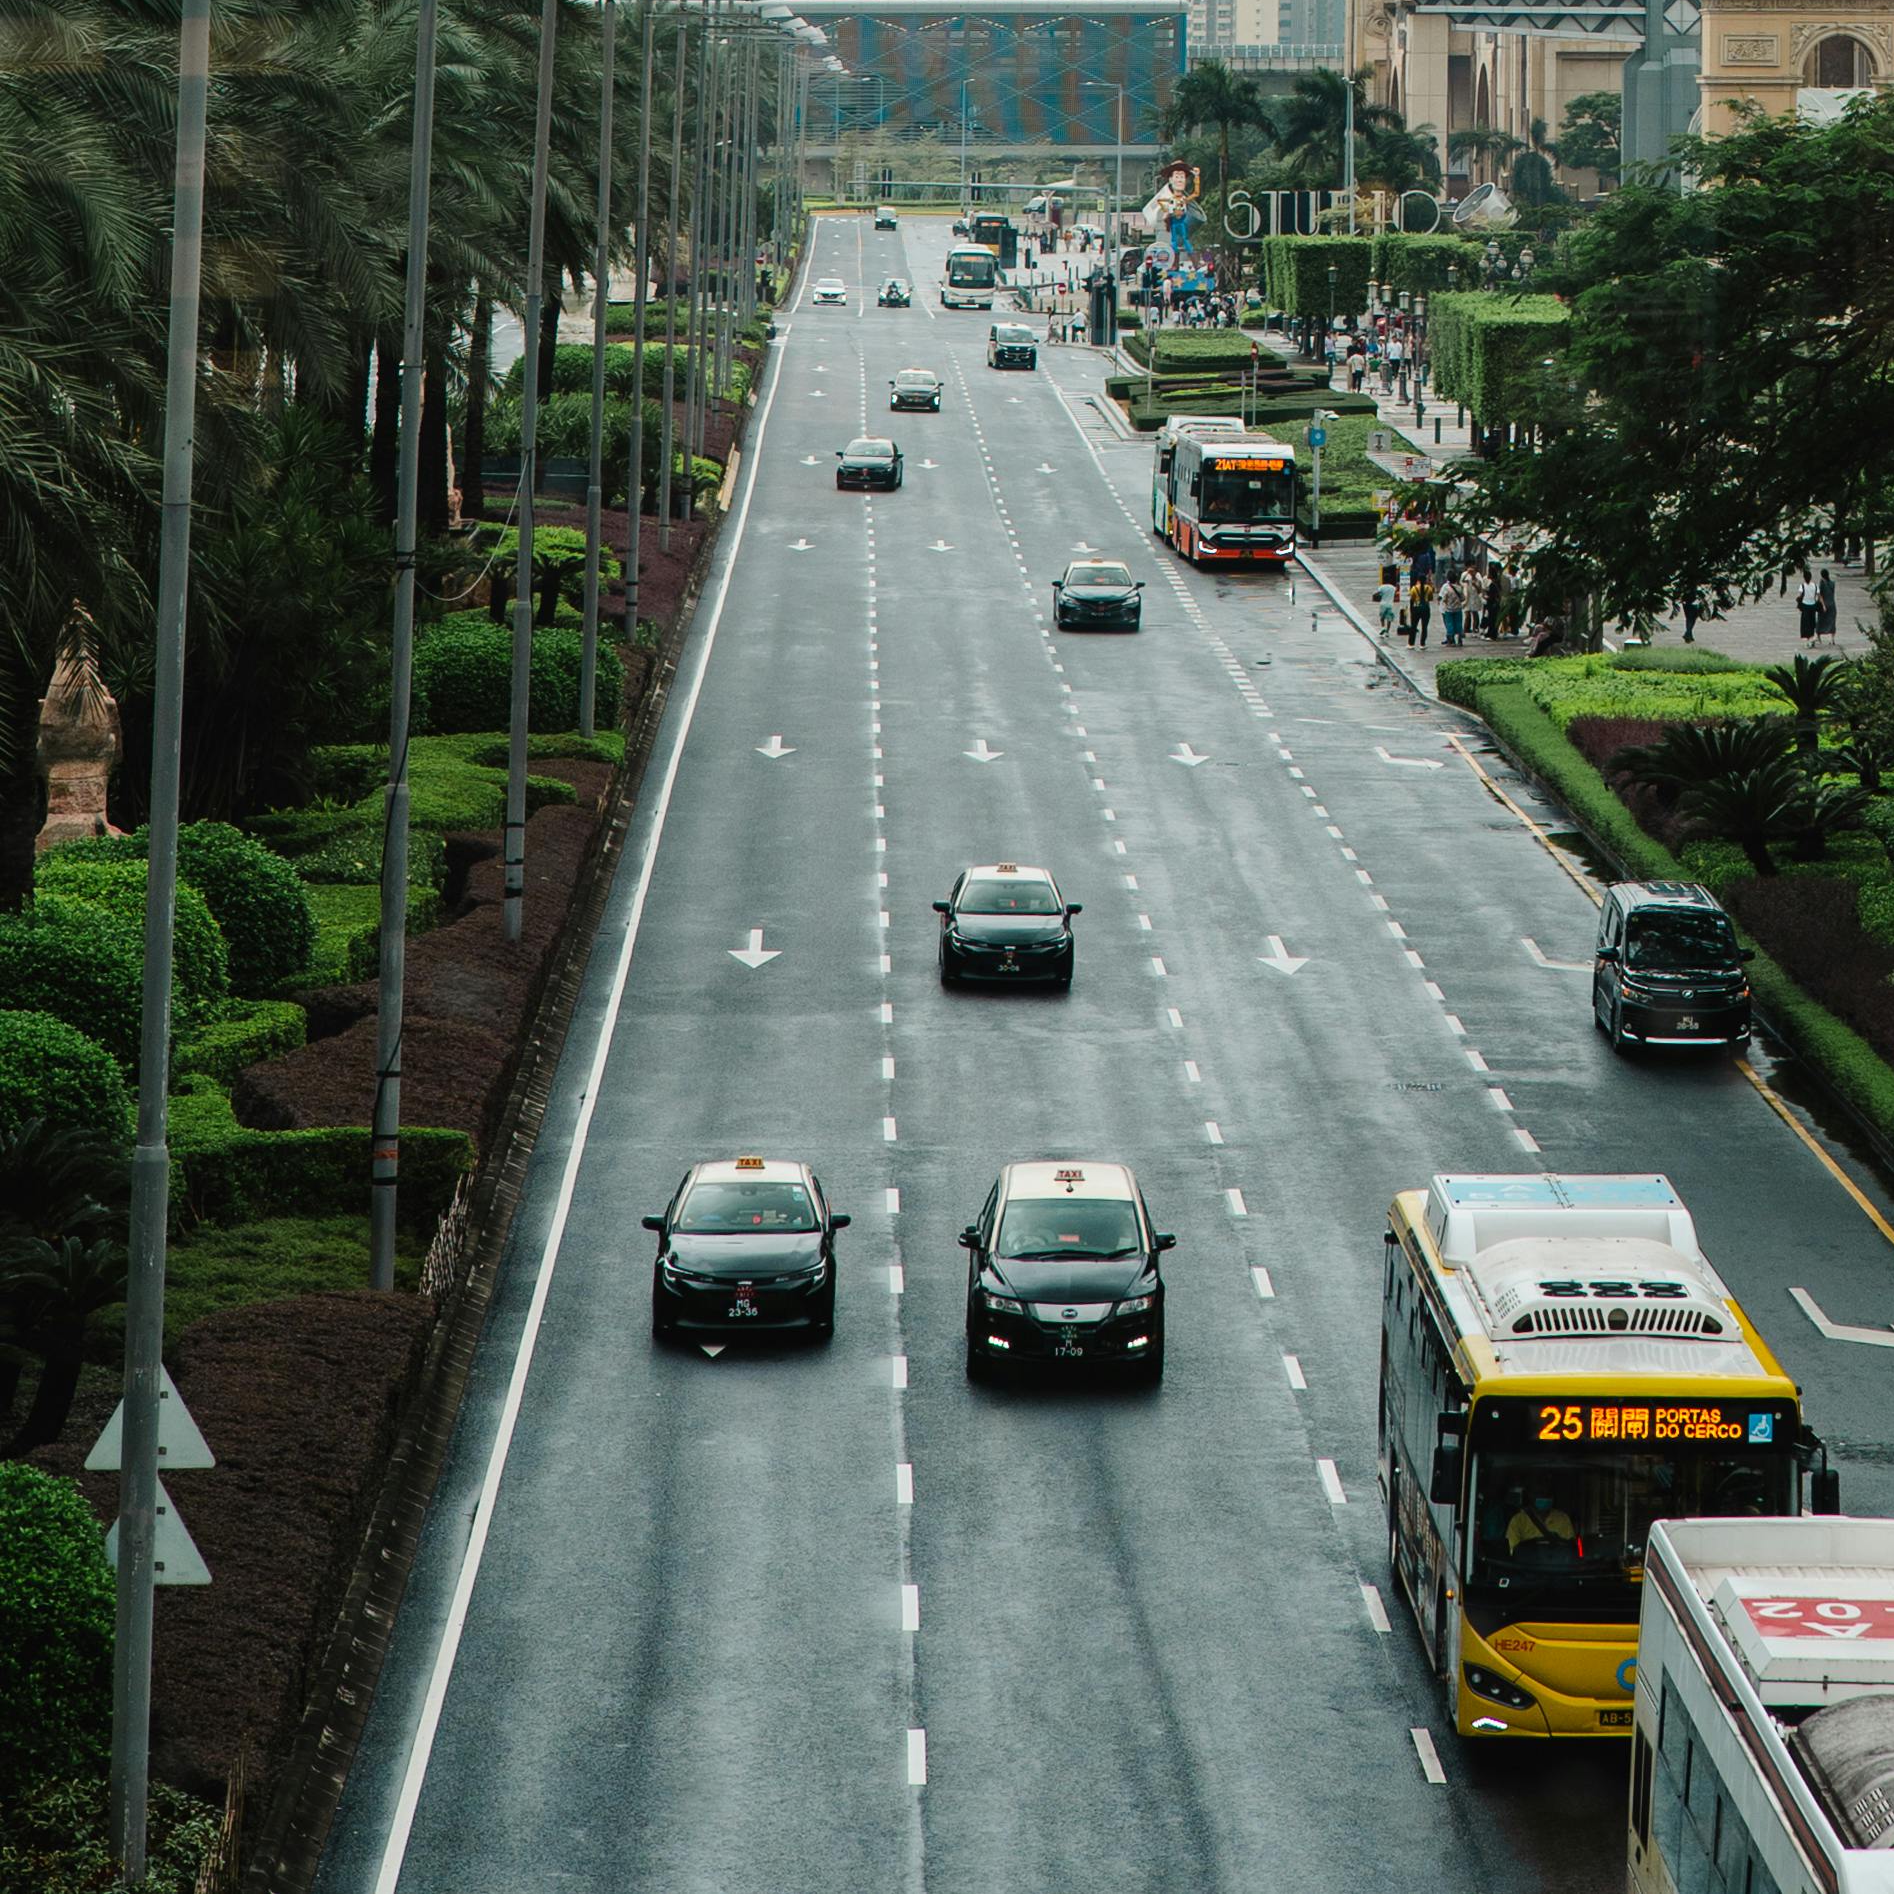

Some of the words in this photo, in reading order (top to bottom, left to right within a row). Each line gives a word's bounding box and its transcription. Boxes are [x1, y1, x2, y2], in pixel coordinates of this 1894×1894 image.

[739, 1158, 763, 1167] TAXI
[1059, 1169, 1083, 1178] TAXI
[1055, 1347, 1083, 1356] 17-09
[1655, 1408, 1721, 1423] PORTAS
[1539, 1406, 1584, 1441] 25
[1590, 1407, 1650, 1439] 關閘
[1655, 1423, 1680, 1439] DO
[1684, 1423, 1742, 1439] CERCO
[1494, 1639, 1536, 1652] HE247
[1602, 1713, 1633, 1724] AB-5
